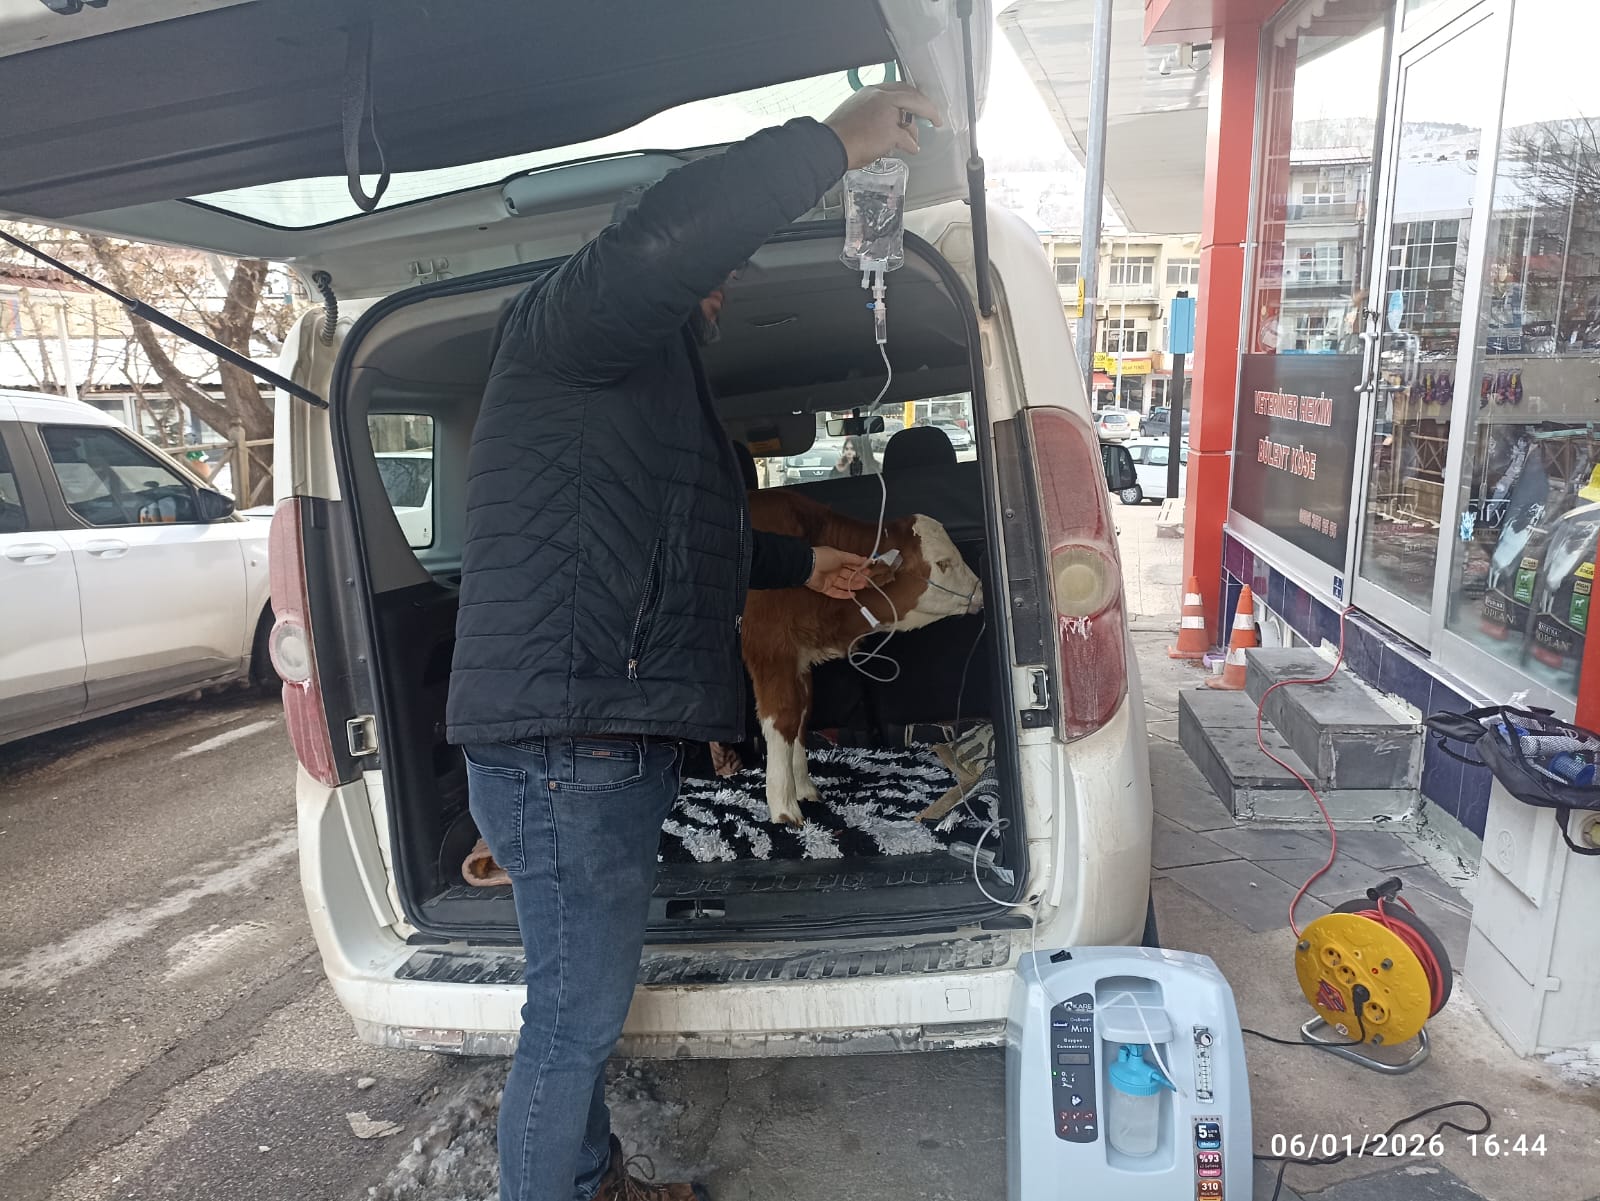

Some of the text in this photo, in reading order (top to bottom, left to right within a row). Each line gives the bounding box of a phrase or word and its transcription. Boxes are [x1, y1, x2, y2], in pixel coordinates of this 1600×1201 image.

[1254, 387, 1333, 427] VETERİNER HEKİM
[1257, 435, 1290, 471] BÜLENT
[1071, 1024, 1092, 1033] Mini
[1198, 1124, 1208, 1139] 5
[1199, 1154, 1219, 1163] %93
[1201, 1182, 1219, 1191] 310
